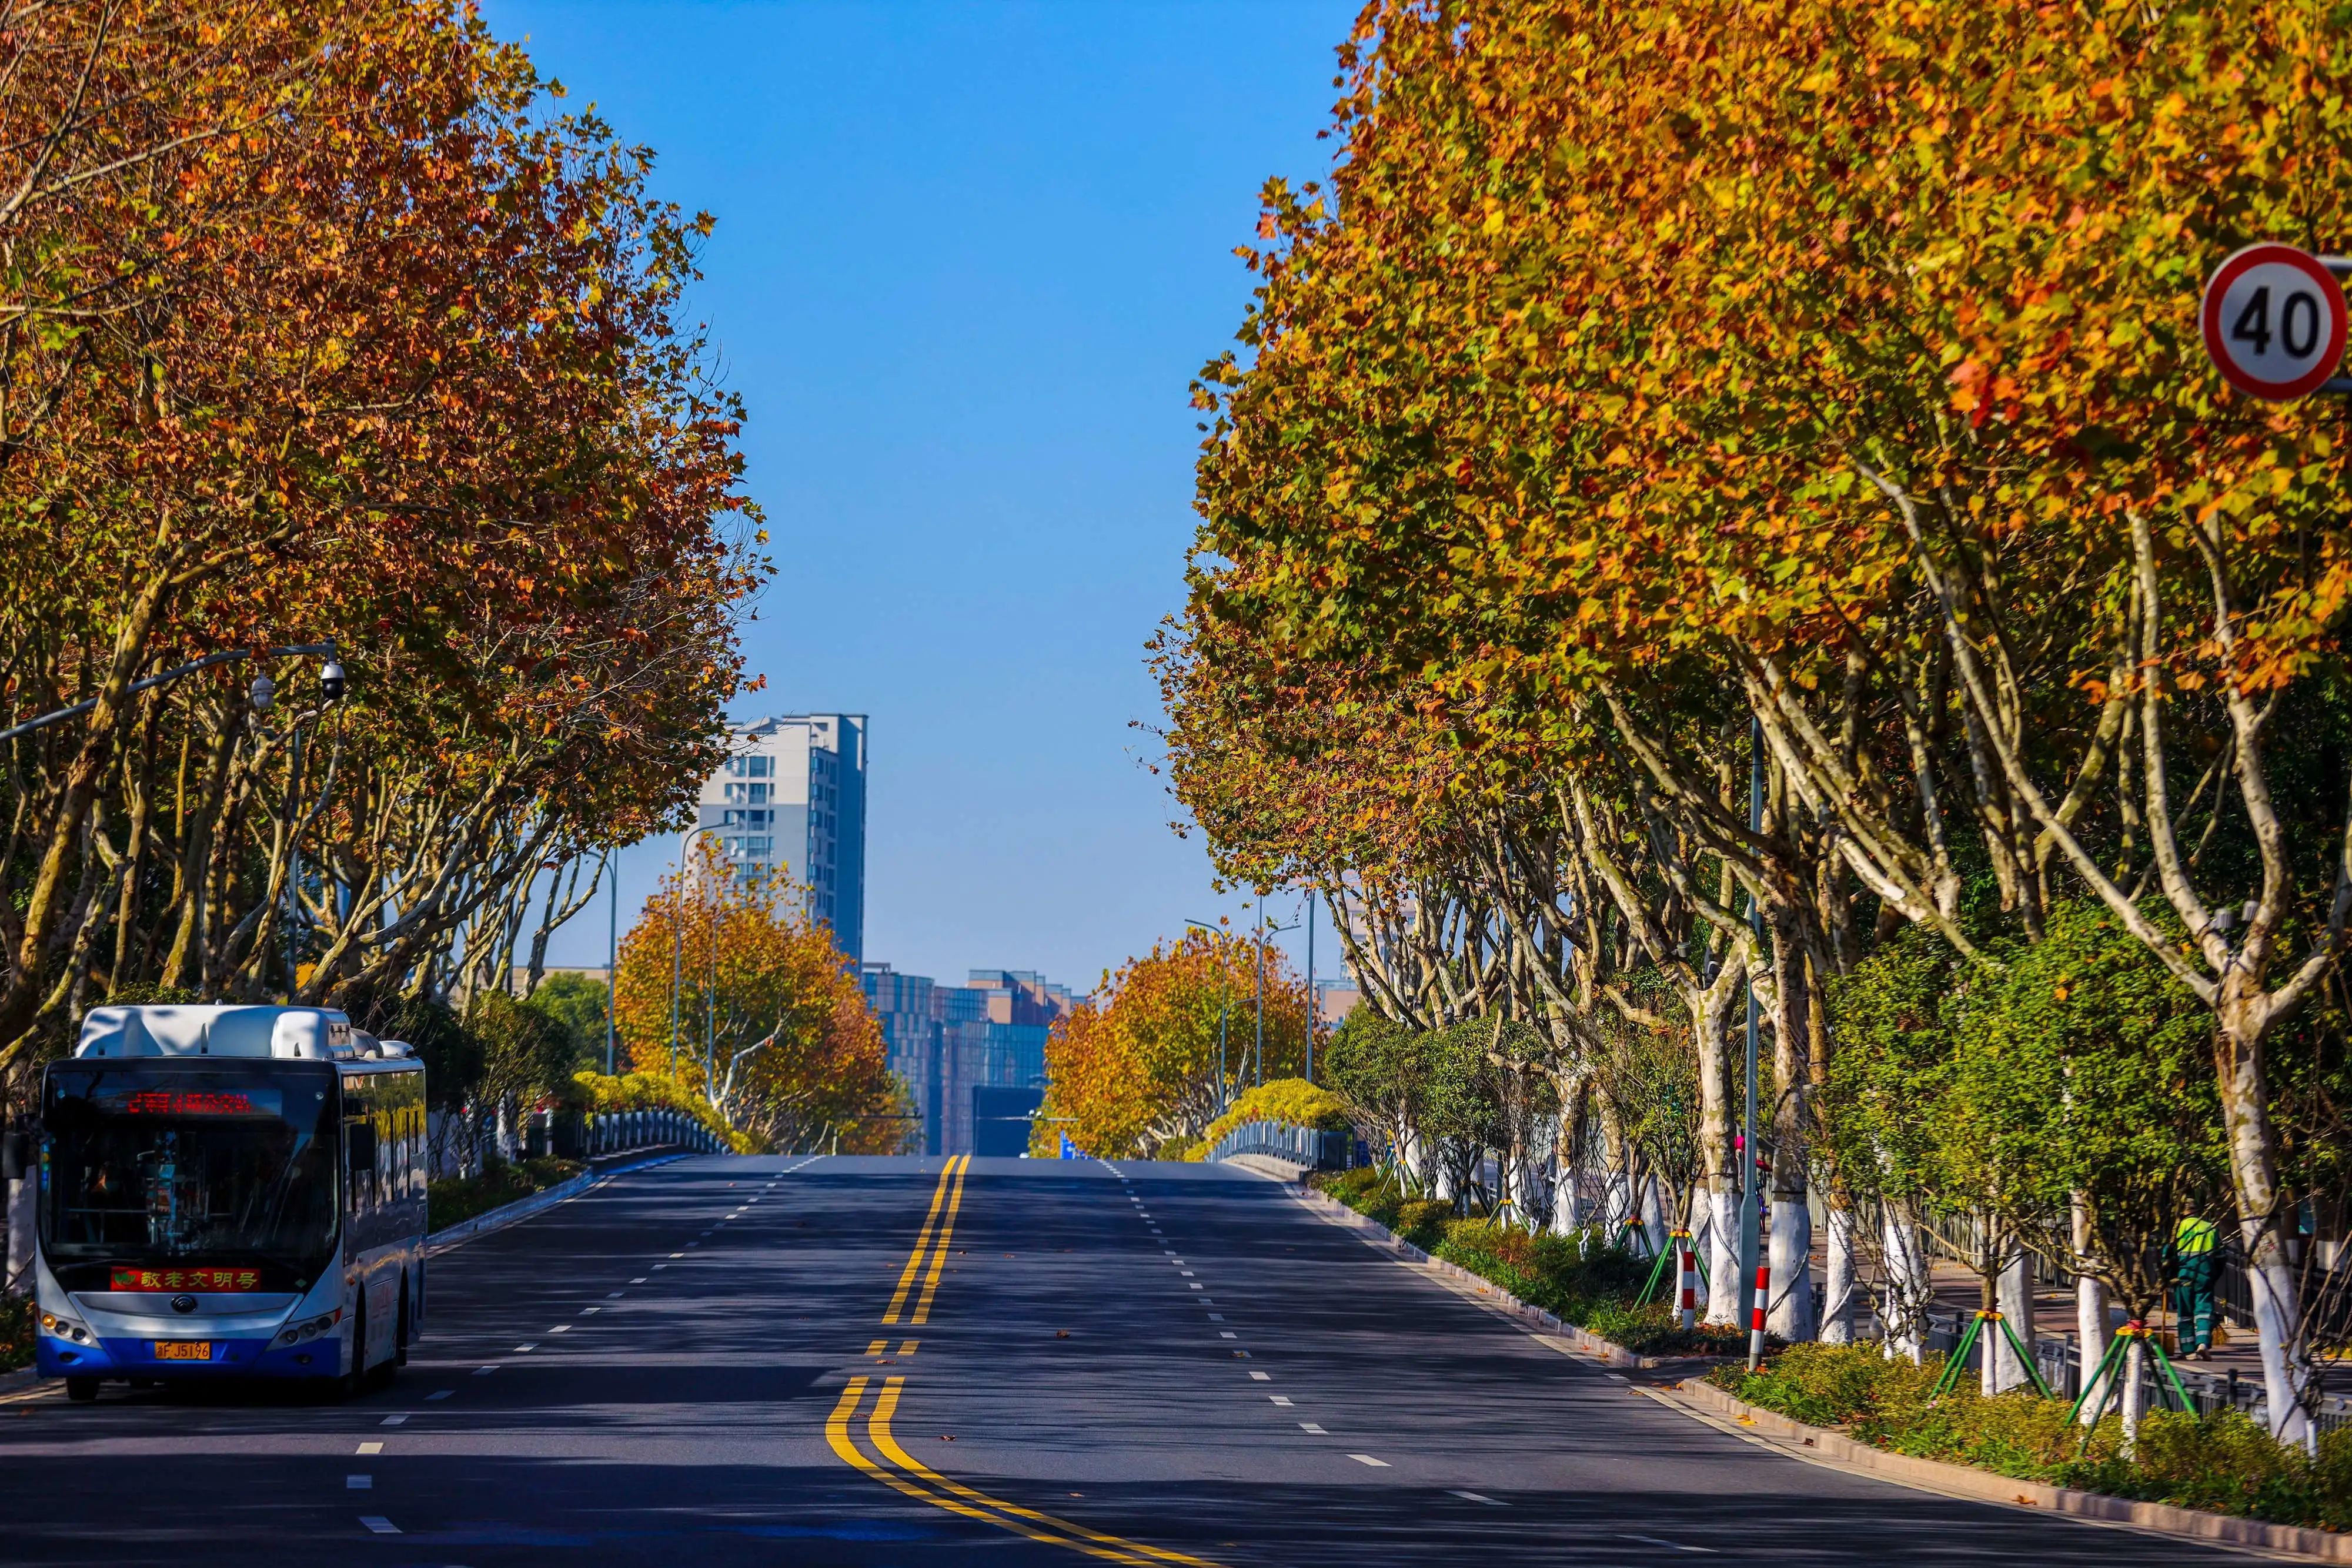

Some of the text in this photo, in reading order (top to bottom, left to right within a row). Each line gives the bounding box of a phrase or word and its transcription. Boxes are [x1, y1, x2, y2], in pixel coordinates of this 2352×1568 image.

[2231, 286, 2319, 358] 40
[141, 1271, 258, 1289] 敬老文明号
